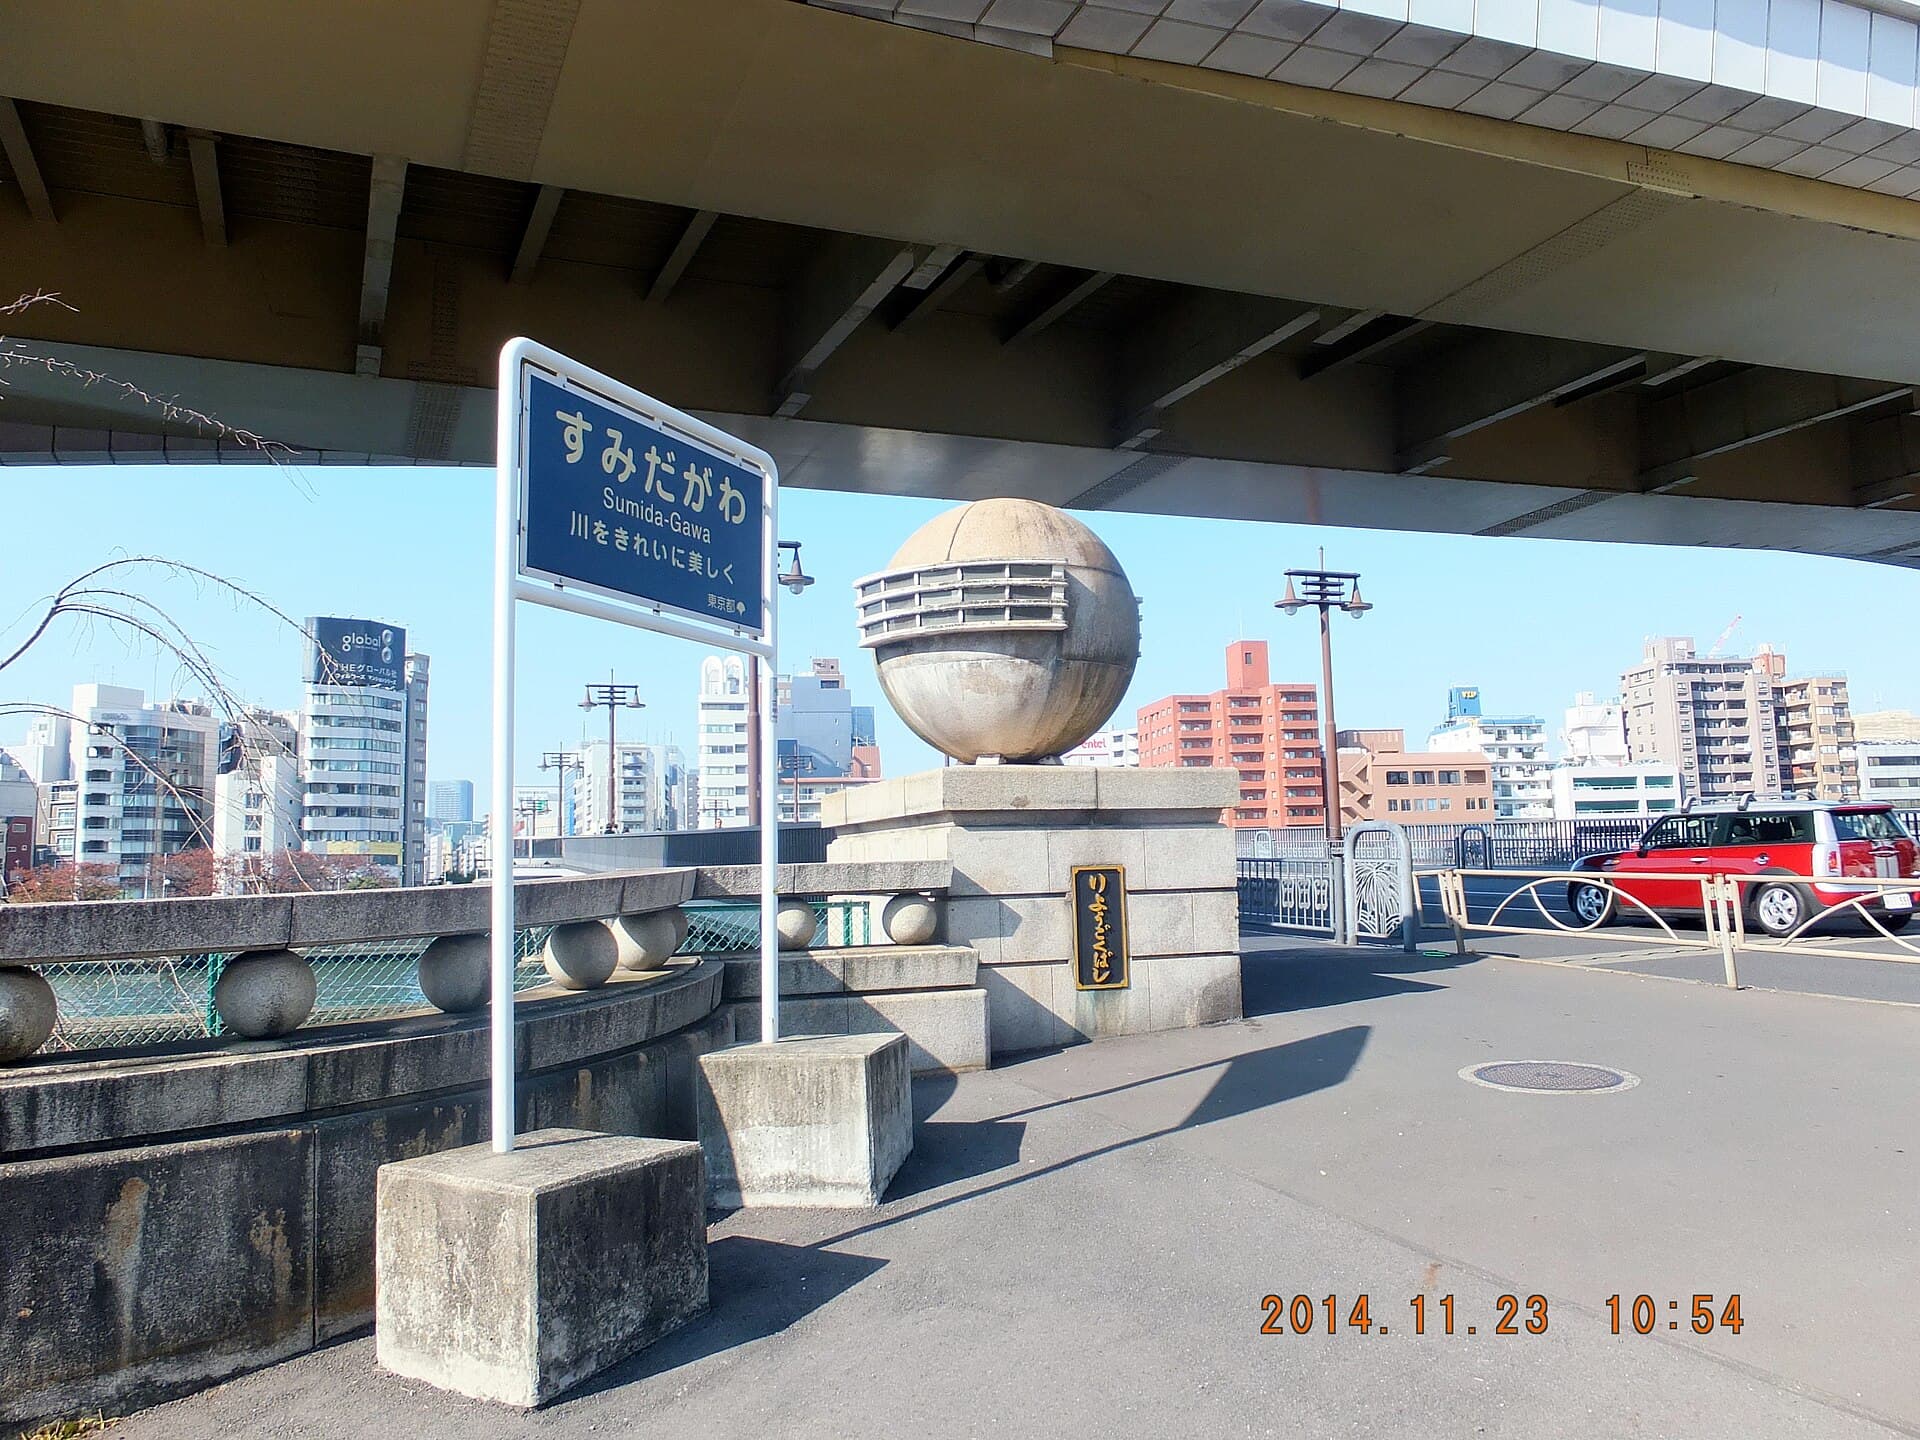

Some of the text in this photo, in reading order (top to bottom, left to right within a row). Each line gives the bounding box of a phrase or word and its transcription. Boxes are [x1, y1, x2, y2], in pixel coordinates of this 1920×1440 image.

[556, 409, 746, 524] すみだがわ
[602, 487, 712, 544] Sumida-Gawa
[570, 510, 735, 584] 川をきれいに美しく
[707, 593, 736, 613] 東京都
[342, 632, 381, 651] global
